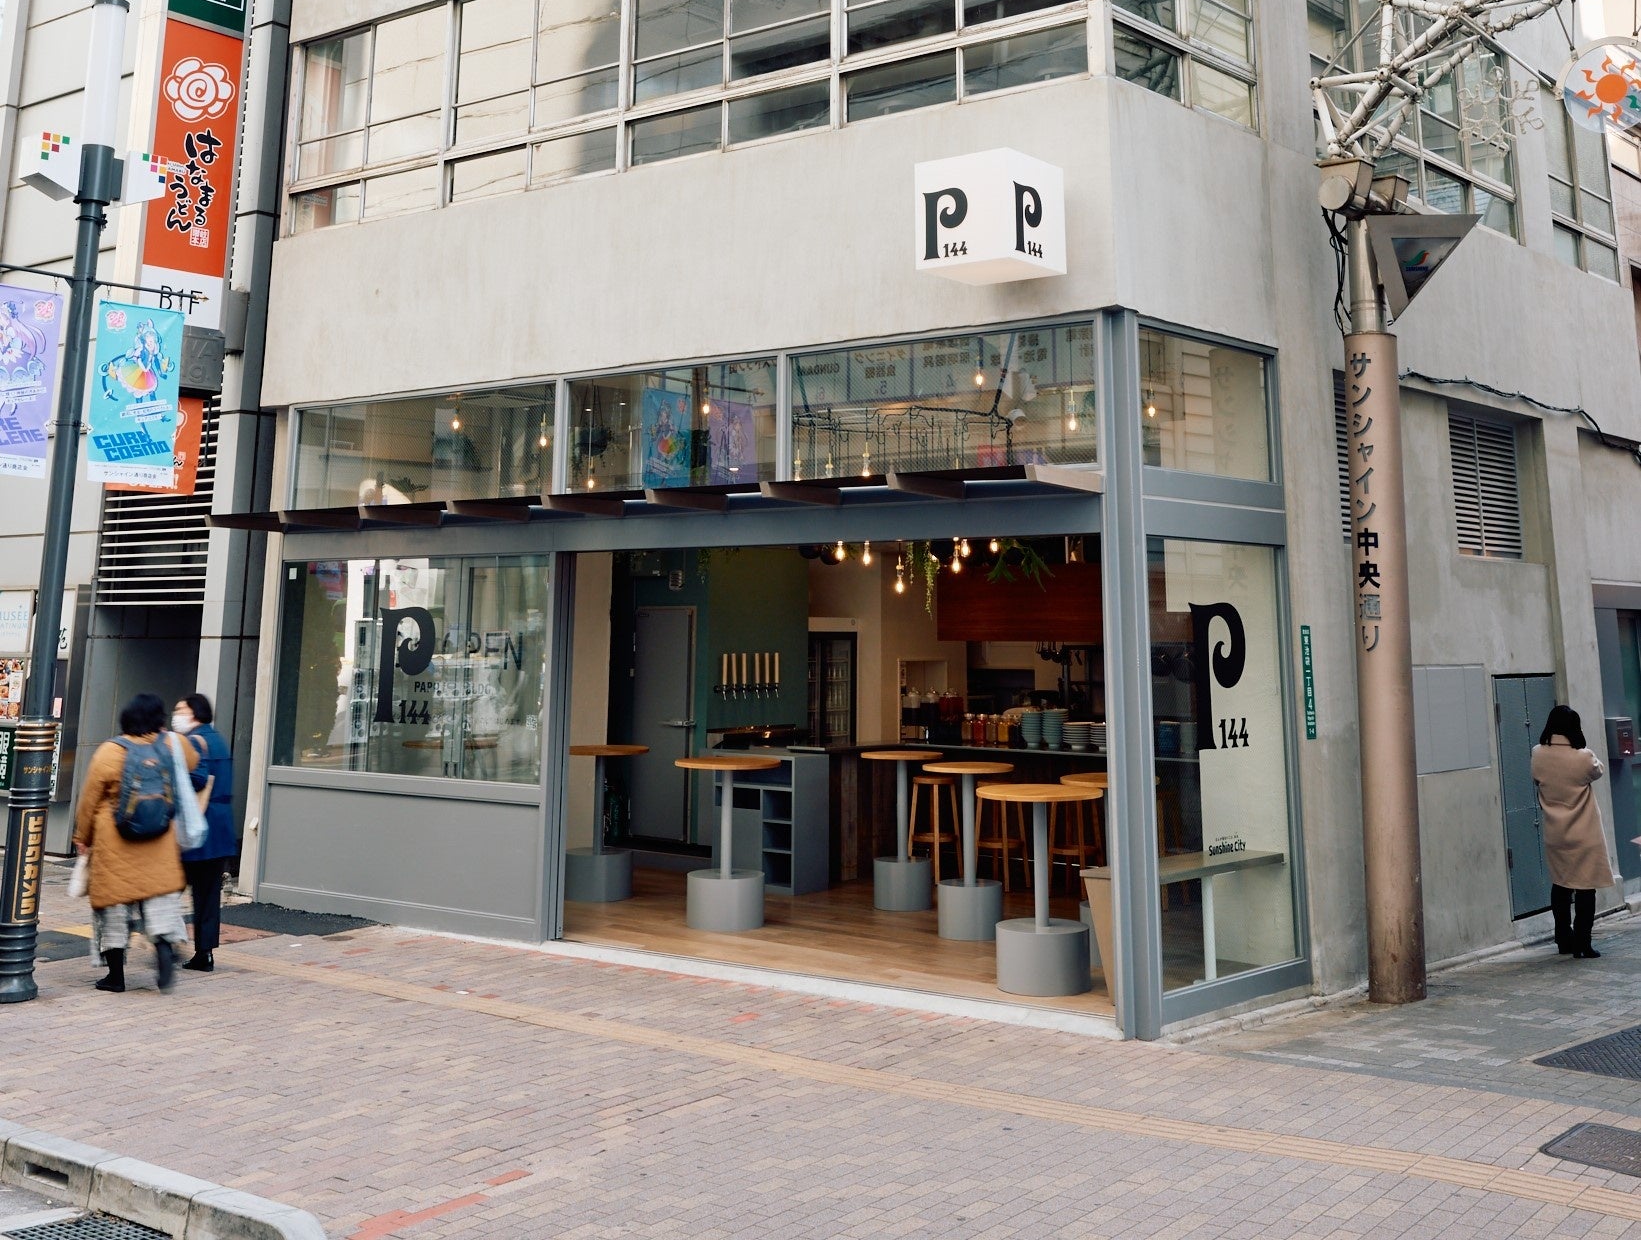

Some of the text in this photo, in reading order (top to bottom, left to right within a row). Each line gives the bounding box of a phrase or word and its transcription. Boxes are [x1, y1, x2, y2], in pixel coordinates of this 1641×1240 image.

[166, 174, 193, 233] うどん
[184, 127, 223, 226] はなまる
[923, 188, 968, 260] P 144
[1013, 180, 1043, 258] P 144
[159, 285, 203, 315] B1F
[104, 440, 171, 461] COSMO
[1350, 352, 1382, 652] サンシャイン中央通り
[373, 606, 436, 723] P
[1188, 602, 1249, 750] P 144
[398, 700, 430, 725] 144
[1208, 839, 1246, 857] Sunshine City
